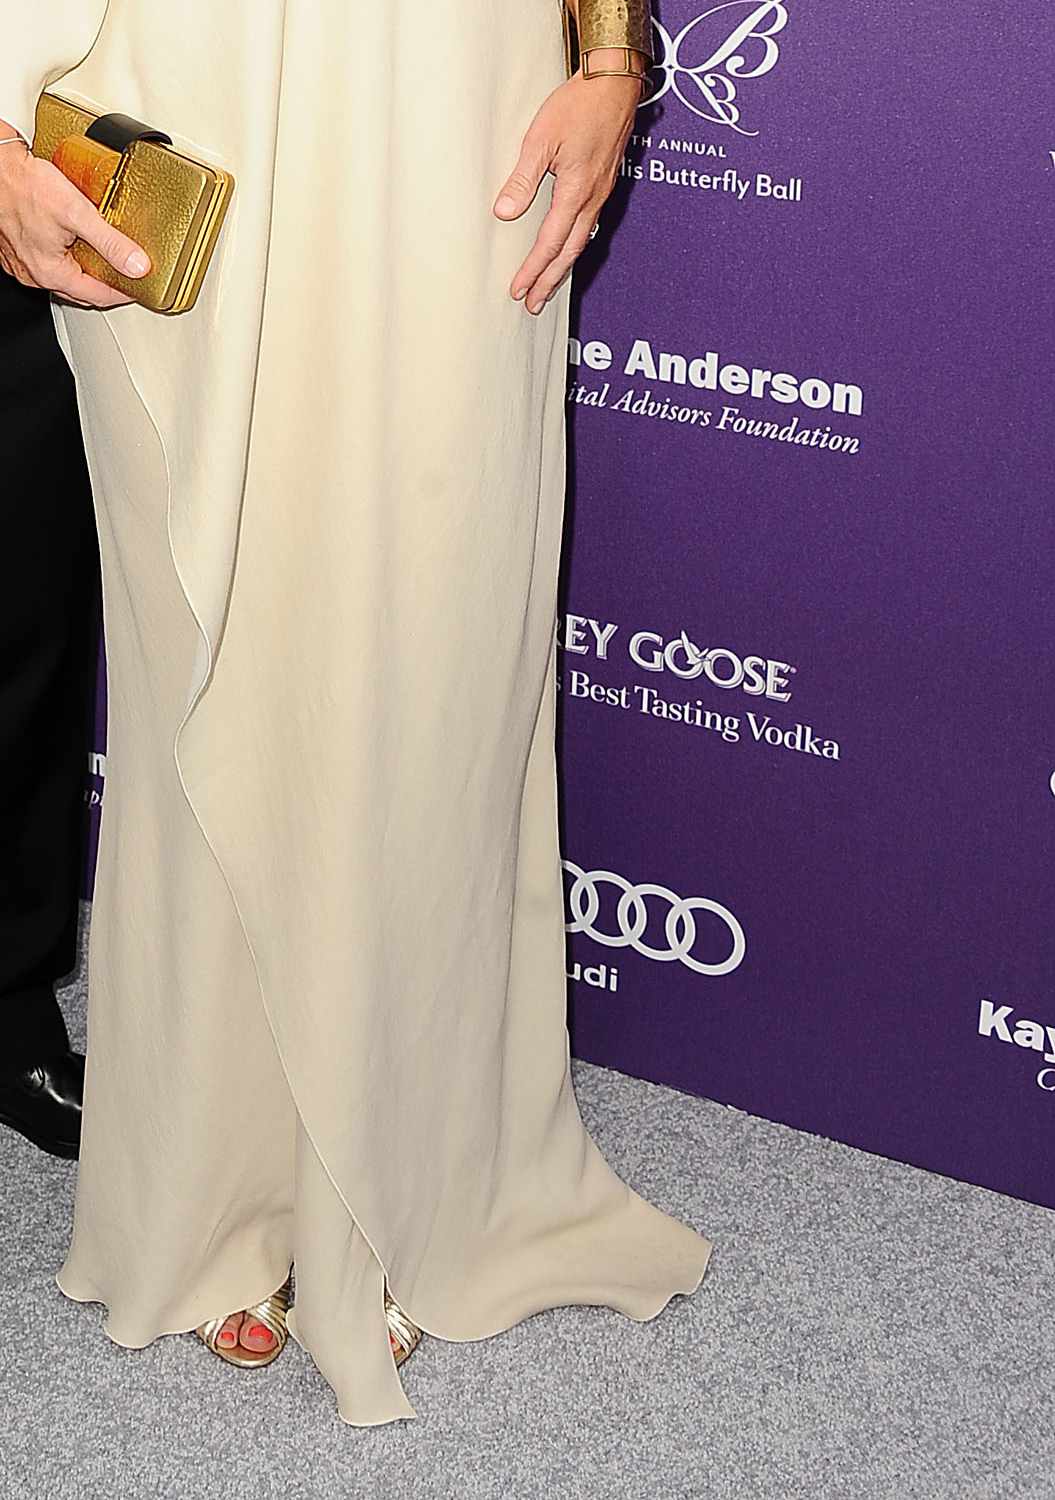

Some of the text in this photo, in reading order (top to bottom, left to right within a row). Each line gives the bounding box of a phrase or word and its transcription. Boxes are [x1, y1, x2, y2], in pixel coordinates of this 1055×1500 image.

[631, 134, 727, 158] TH ANNUAL
[649, 159, 751, 200] Butterfly
[755, 173, 802, 202] Ball
[623, 339, 863, 416] Anderson
[568, 381, 861, 455] ital Advisors Foundation
[557, 614, 792, 703] EY GOOSE
[569, 670, 840, 760] Best Tasting Vodka
[566, 963, 618, 992] udi
